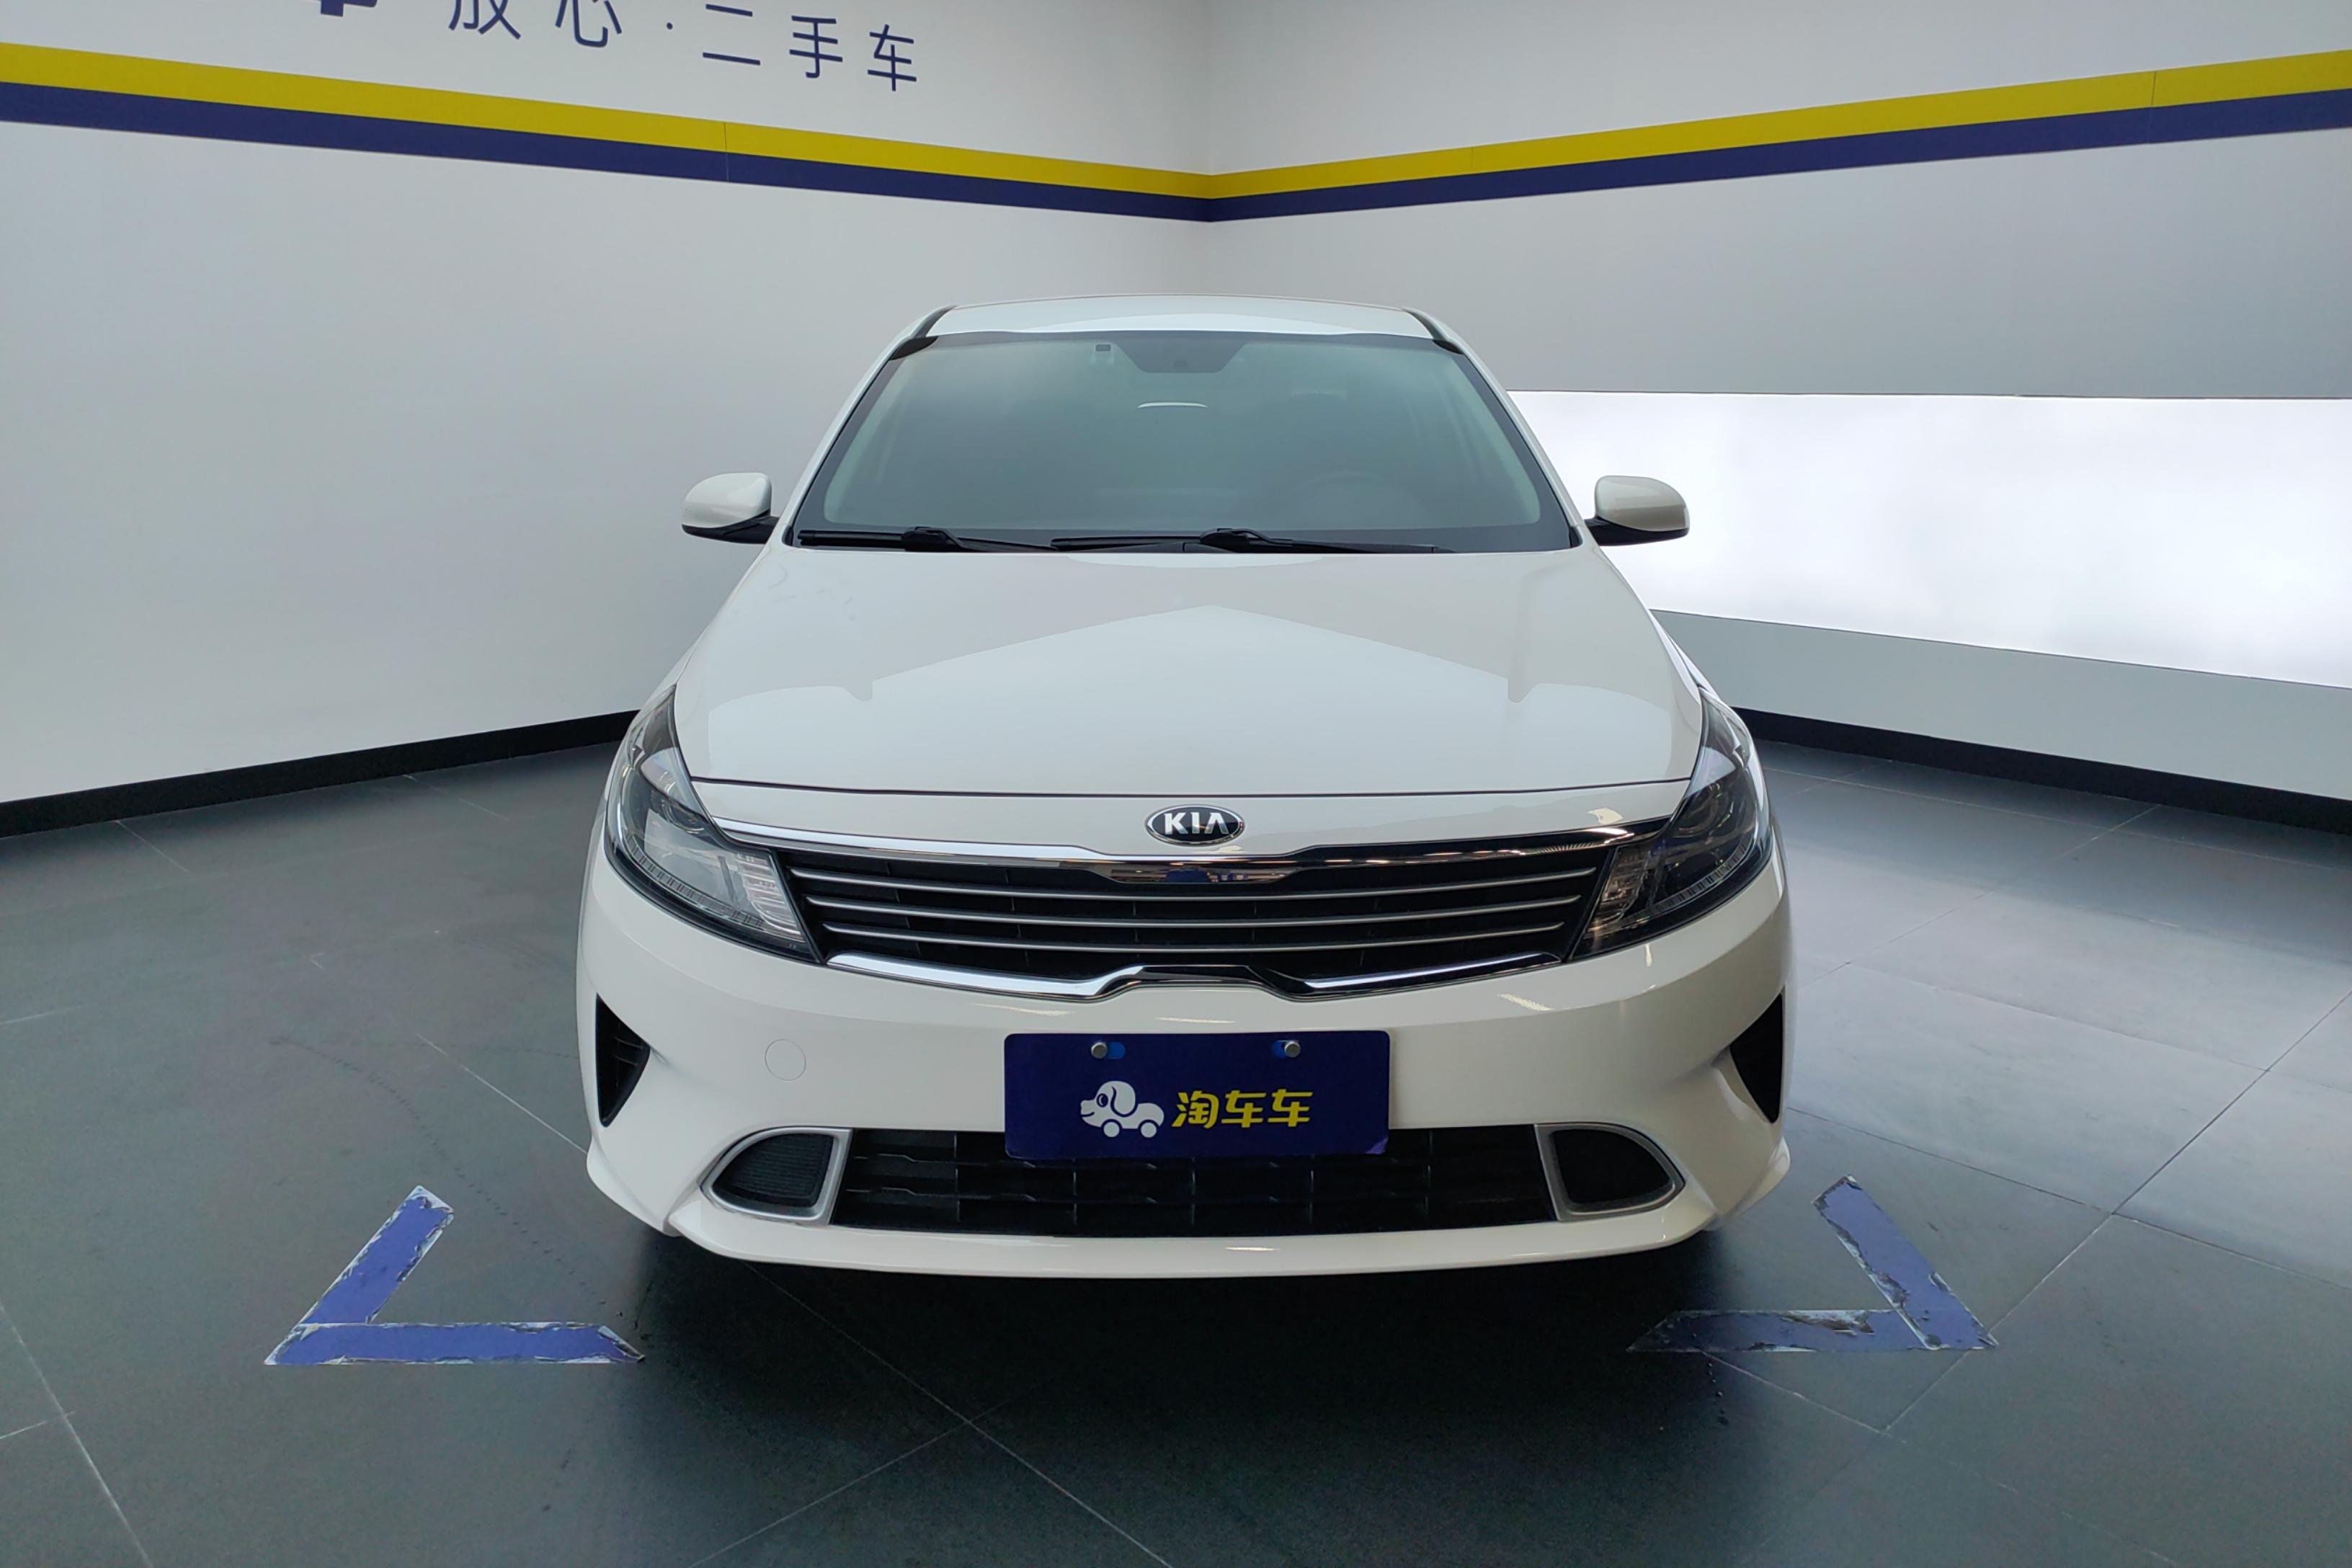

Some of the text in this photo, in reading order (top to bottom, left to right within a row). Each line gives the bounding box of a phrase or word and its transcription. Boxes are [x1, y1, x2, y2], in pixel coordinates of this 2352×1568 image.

[1164, 811, 1229, 835] KIA
[1172, 1089, 1313, 1128] 淘车车
